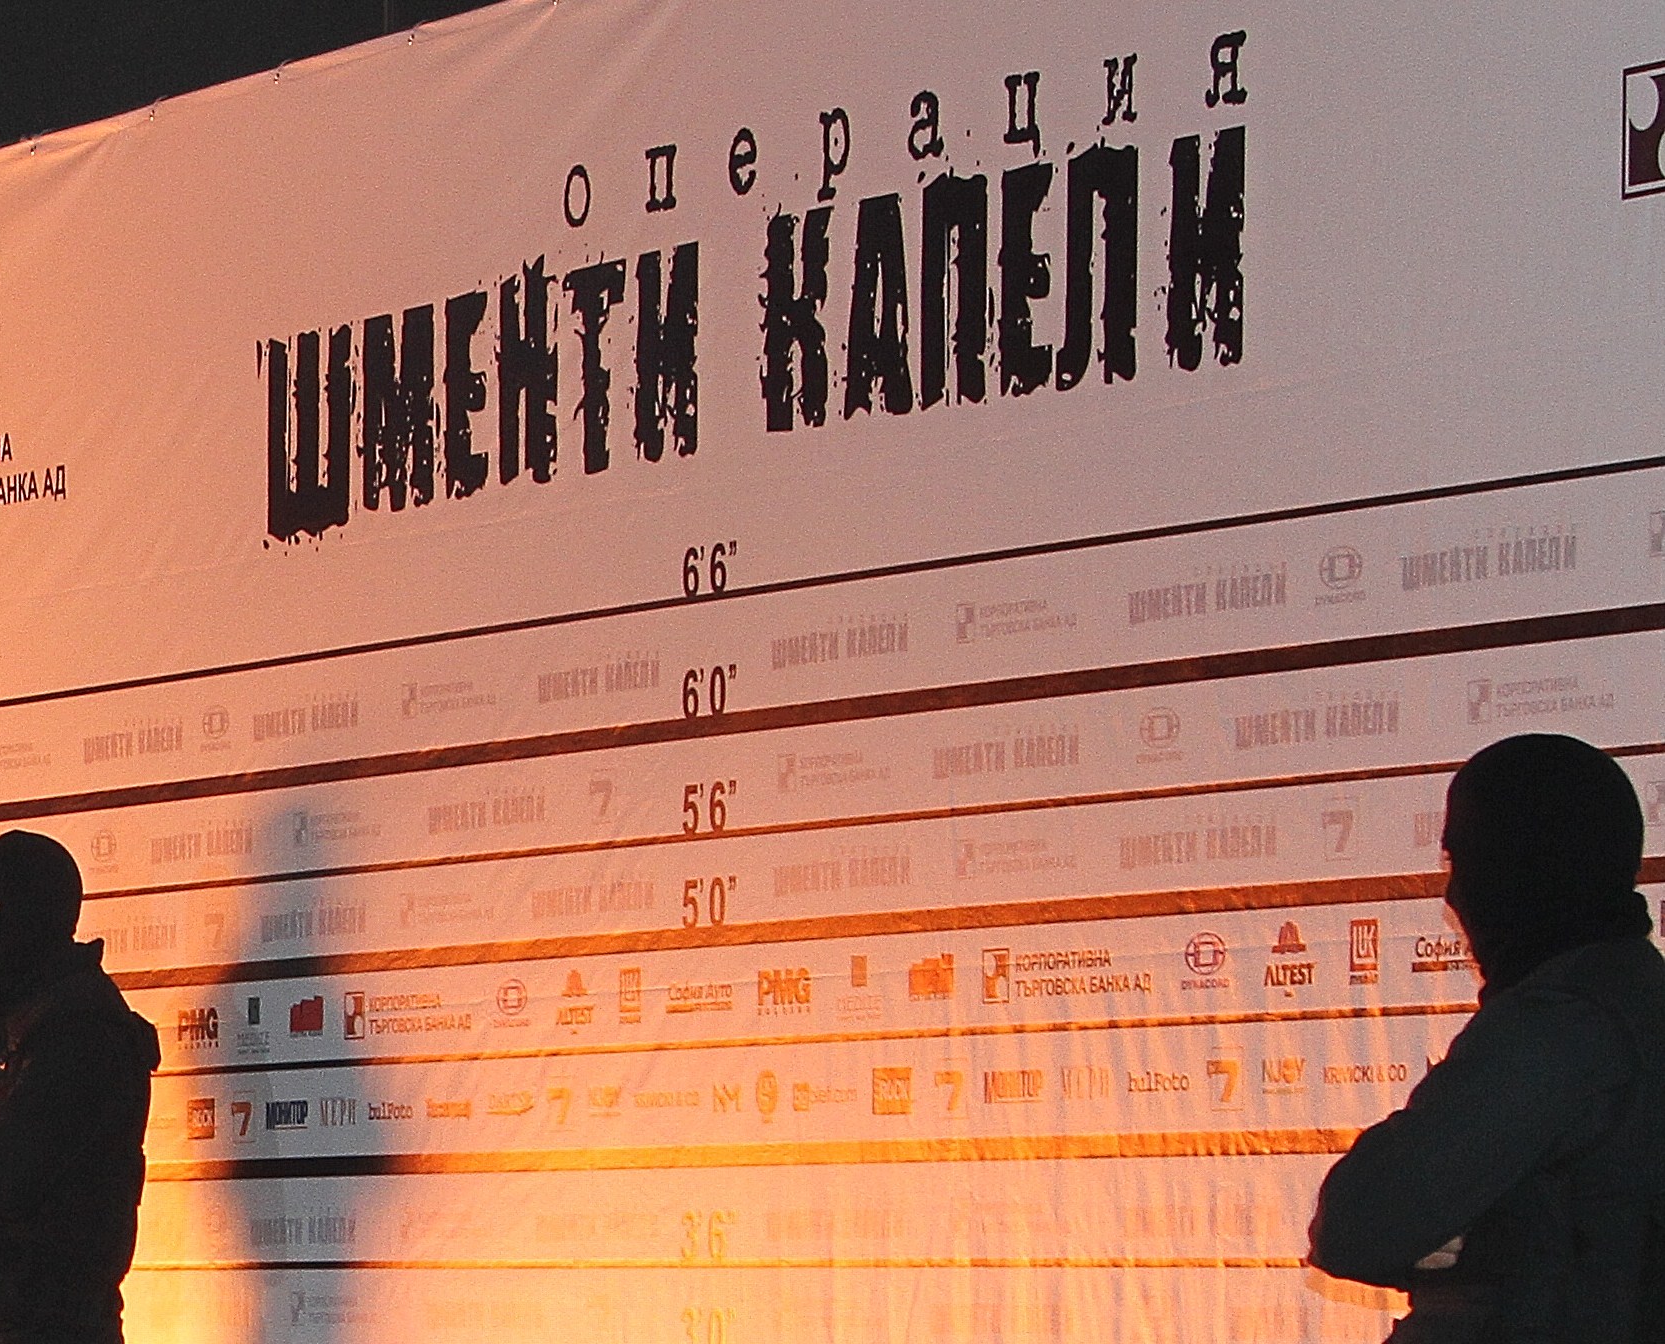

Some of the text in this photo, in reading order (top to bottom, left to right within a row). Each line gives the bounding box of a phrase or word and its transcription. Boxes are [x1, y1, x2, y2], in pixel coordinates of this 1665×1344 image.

[562, 30, 1249, 228] операция
[257, 125, 1246, 550] ШМЕНТИ КАПЕЛИ
[44, 464, 67, 501] АД
[1415, 934, 1461, 961] София
[758, 967, 811, 1006] PMG
[1090, 973, 1131, 994] БАНКА
[1134, 972, 1153, 994] АД
[1264, 962, 1315, 987] ALTEST
[1388, 1063, 1407, 1083] CO
